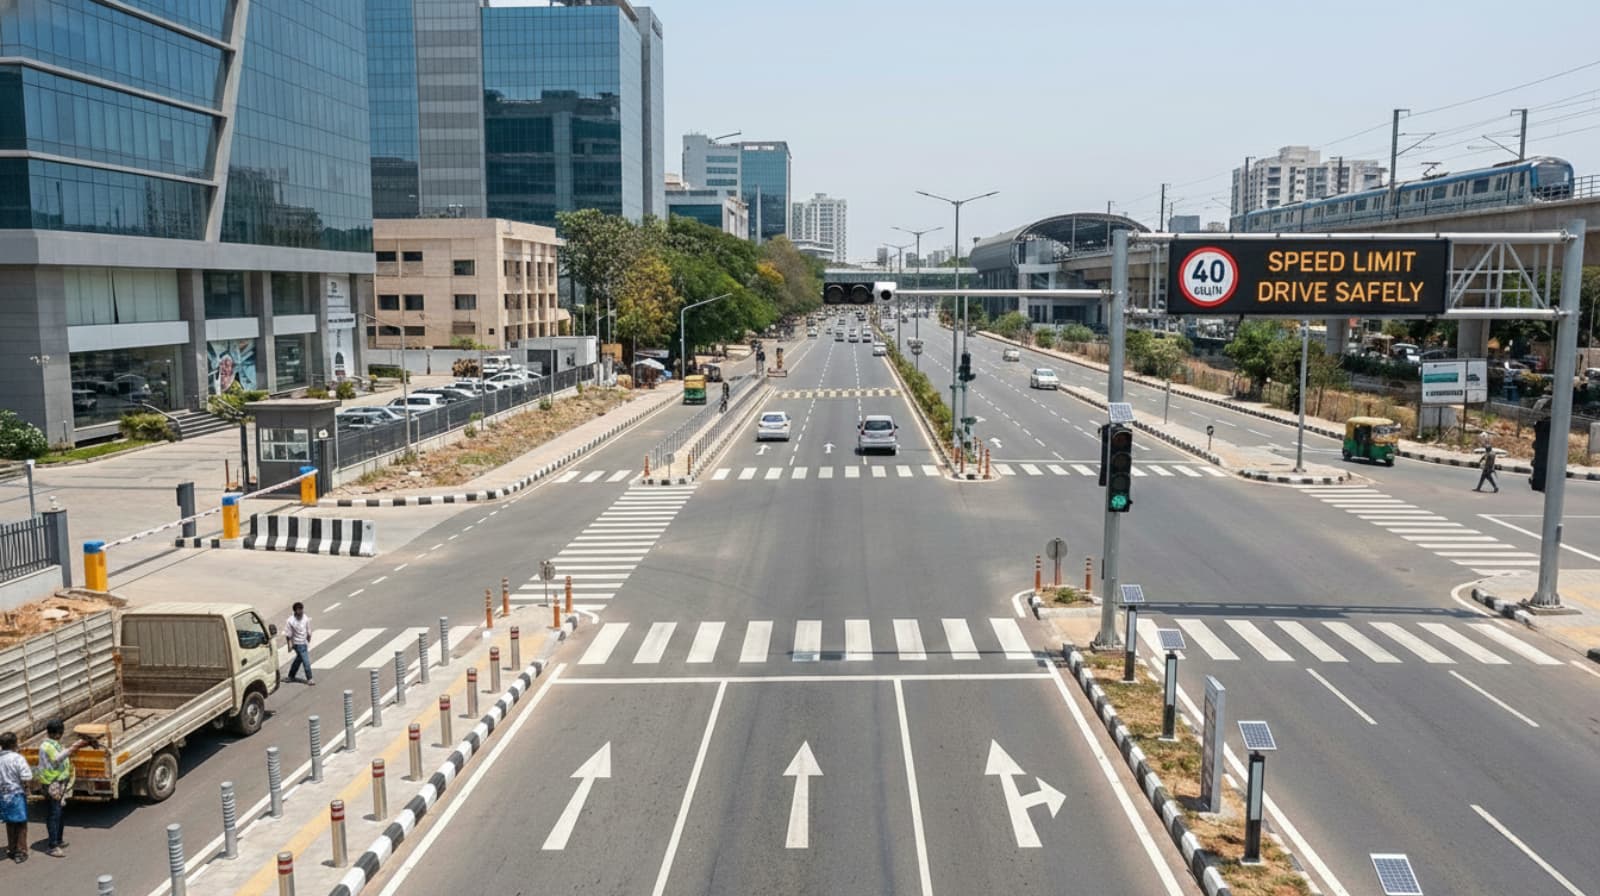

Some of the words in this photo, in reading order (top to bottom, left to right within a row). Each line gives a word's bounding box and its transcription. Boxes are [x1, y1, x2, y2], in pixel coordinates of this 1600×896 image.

[1192, 260, 1225, 283] 40
[1268, 251, 1345, 272] SPEED
[1352, 251, 1416, 272] LIMIT
[1257, 281, 1327, 303] DRIVE
[1335, 281, 1424, 303] SAFELY
